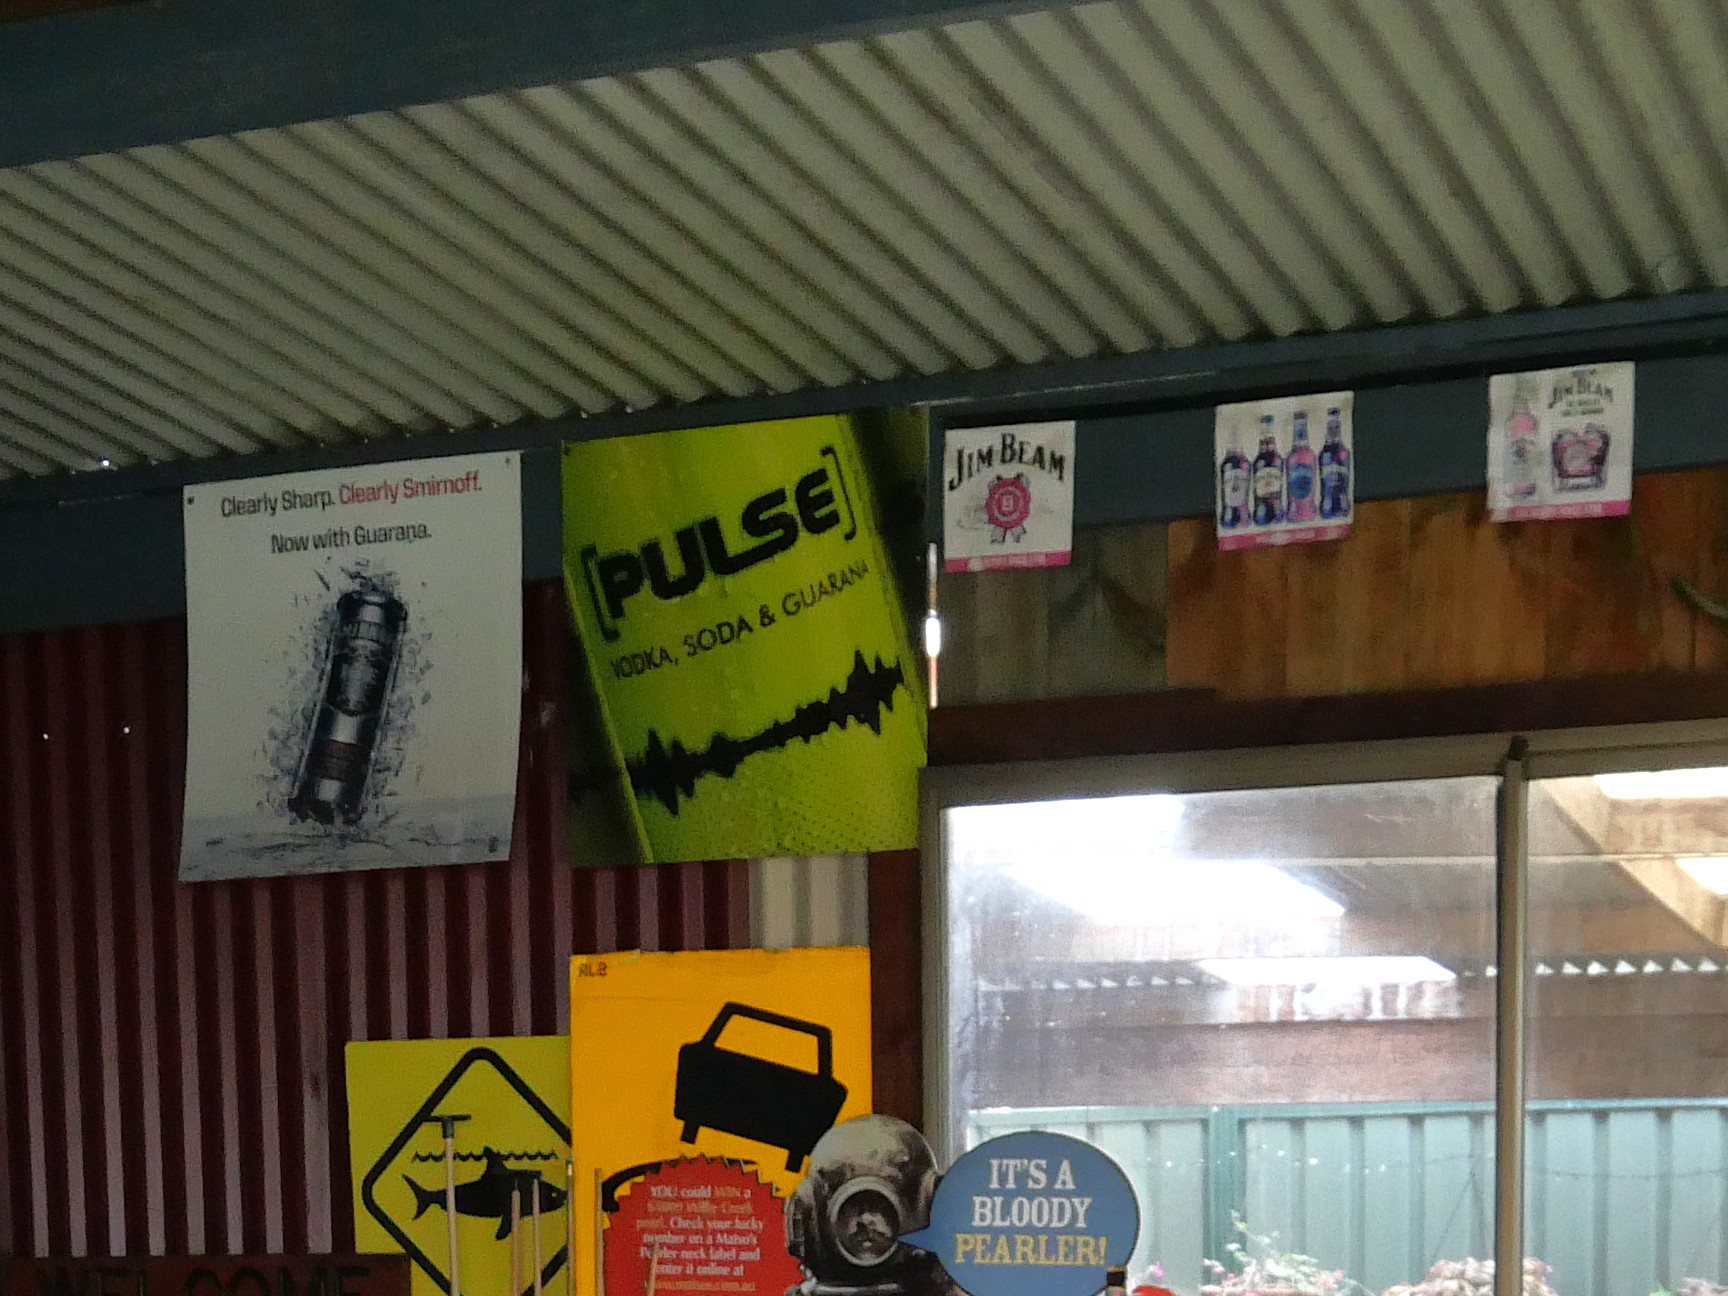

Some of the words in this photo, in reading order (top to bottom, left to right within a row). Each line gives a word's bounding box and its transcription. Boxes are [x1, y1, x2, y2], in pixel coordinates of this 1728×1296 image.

[949, 446, 993, 491] JIM
[1000, 433, 1065, 481] BEAM
[221, 490, 278, 517] Clearly
[282, 488, 335, 511] Sharp.
[338, 480, 399, 505] Clearly
[402, 469, 482, 498] Smirnoff.
[271, 533, 309, 554] Now
[313, 526, 350, 549] with
[354, 521, 432, 545] Guarana.
[609, 647, 679, 680] VODKA,
[683, 614, 753, 657] SODA
[759, 604, 776, 629] &
[781, 559, 869, 616] GUARANA
[989, 1158, 1047, 1189] IT'S
[1053, 1159, 1075, 1190] A
[680, 1185, 712, 1198] could
[670, 1217, 704, 1229] Check
[707, 1219, 733, 1233] your
[735, 1216, 764, 1232] lucky
[971, 1196, 1092, 1228] BLOODY
[643, 1231, 685, 1244] number
[688, 1234, 703, 1244] on
[681, 1247, 706, 1259] neck
[710, 1247, 736, 1260] label
[739, 1248, 760, 1260] and
[954, 1233, 1108, 1265] PEARLER!
[686, 1264, 694, 1275] it
[696, 1263, 731, 1276] online
[733, 1265, 744, 1276] at
